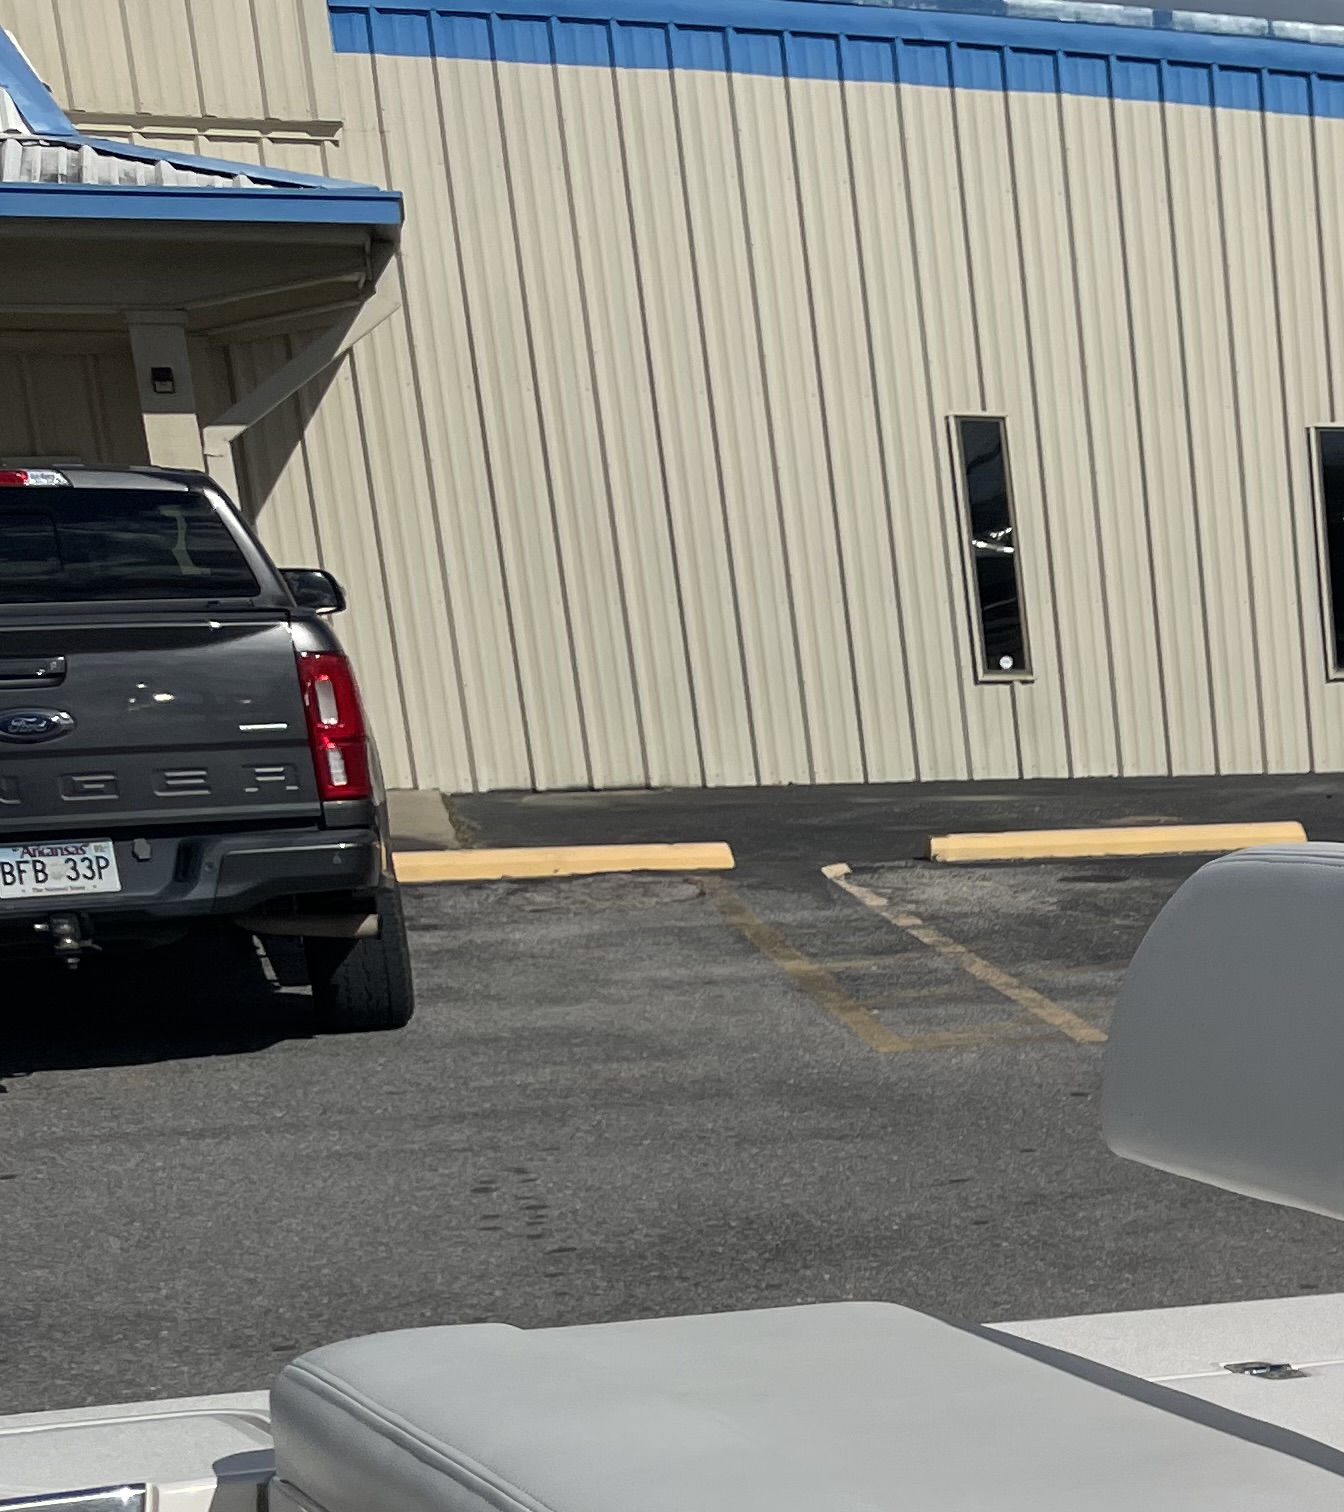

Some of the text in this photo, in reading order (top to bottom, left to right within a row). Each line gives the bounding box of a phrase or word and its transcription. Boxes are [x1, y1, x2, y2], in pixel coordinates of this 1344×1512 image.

[20, 843, 89, 858] Arkansas
[1, 856, 110, 886] BFB 33P
